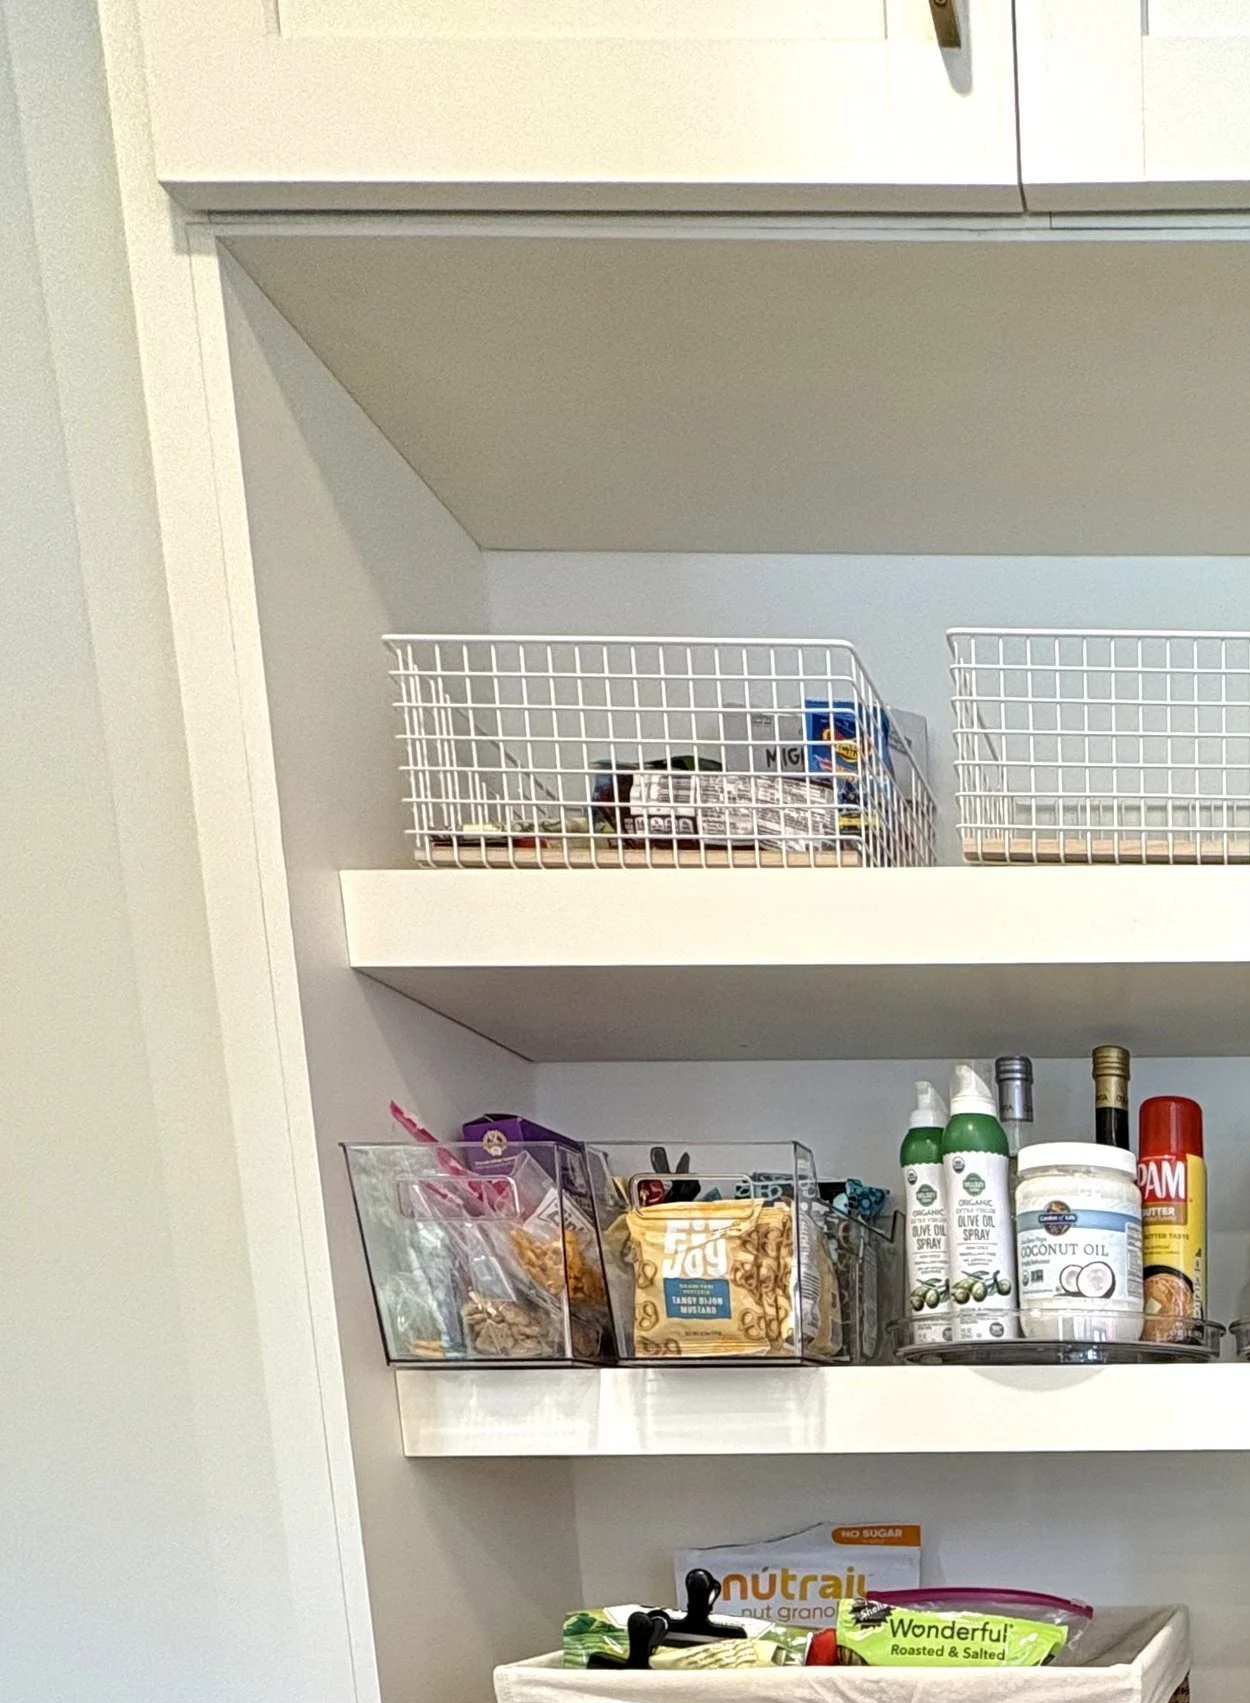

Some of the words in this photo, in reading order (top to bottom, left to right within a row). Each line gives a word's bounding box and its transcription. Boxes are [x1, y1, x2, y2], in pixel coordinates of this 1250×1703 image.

[912, 1209, 945, 1217] ORGANIC
[1143, 1207, 1175, 1216] UTTER
[957, 1215, 980, 1228] OLIVE
[982, 1215, 995, 1228] OIL
[912, 1224, 931, 1237] OLIVE
[963, 1228, 990, 1241] SPRAY
[916, 1237, 942, 1250] SPRAY
[1021, 1244, 1078, 1258] COCONUT
[1083, 1244, 1109, 1257] OIL
[680, 1306, 717, 1314] MUSTARD
[841, 1530, 859, 1538] NO
[862, 1529, 904, 1538] SUGAR
[741, 1604, 776, 1619] nut
[890, 1618, 1008, 1643] Wonderful
[891, 1644, 944, 1657] Roasted
[948, 1646, 959, 1658] &
[963, 1647, 1005, 1661] Salted
